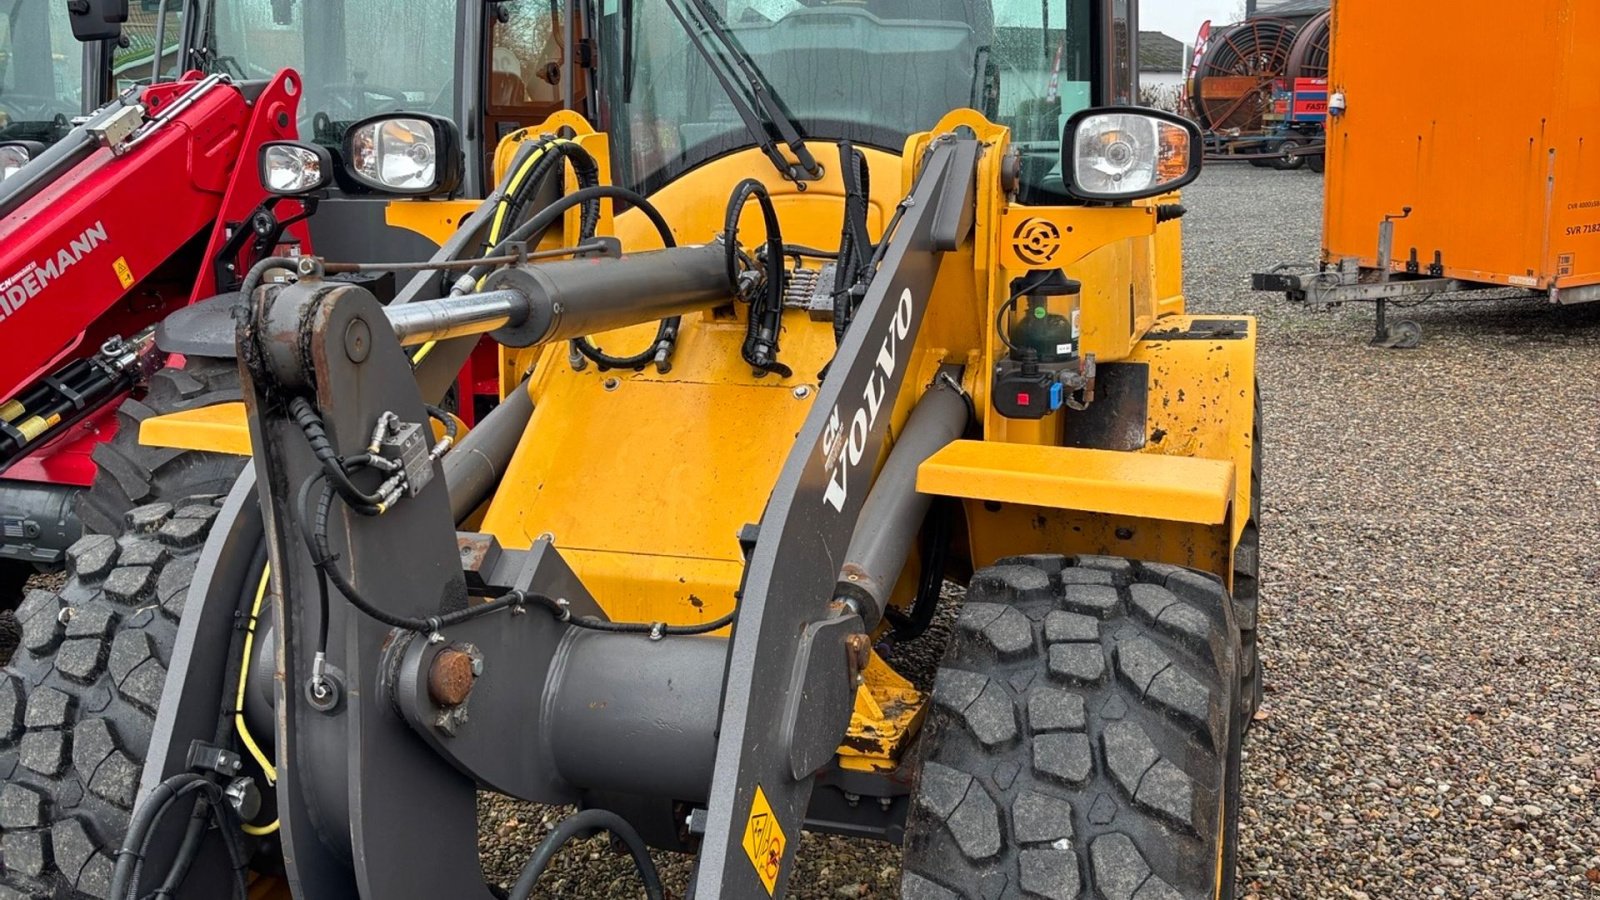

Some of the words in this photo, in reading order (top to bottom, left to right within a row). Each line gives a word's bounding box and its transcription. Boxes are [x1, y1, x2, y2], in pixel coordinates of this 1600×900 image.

[0, 220, 108, 322] IDEMANN
[1565, 226, 1581, 236] SVR
[822, 287, 912, 513] VOLVO
